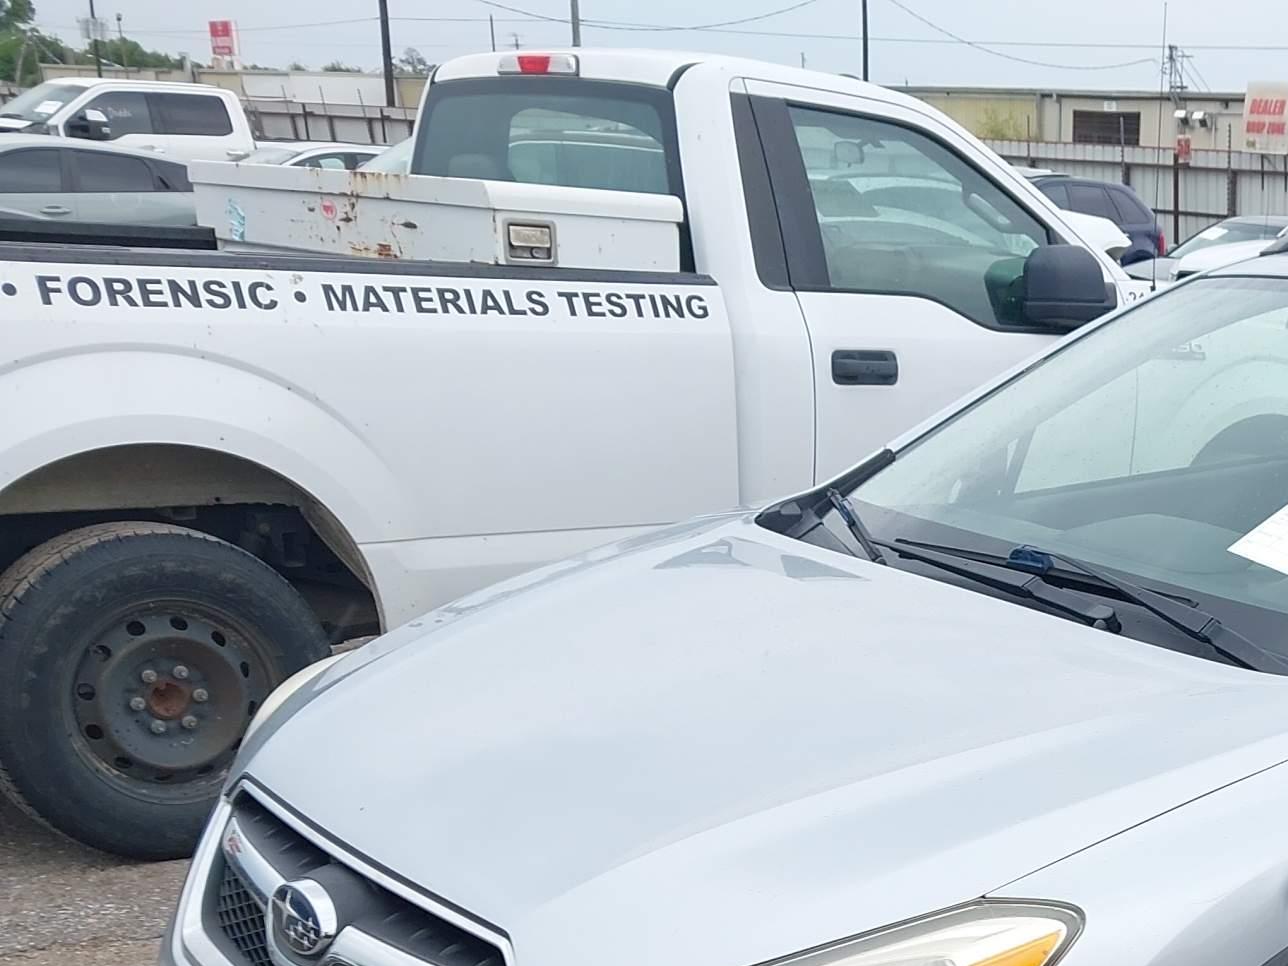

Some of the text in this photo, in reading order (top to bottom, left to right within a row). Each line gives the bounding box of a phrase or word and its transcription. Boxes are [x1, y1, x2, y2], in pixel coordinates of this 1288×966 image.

[1249, 98, 1287, 115] DEALER
[35, 275, 279, 311] FORENSIC
[321, 283, 710, 320] MATERIALS TESTING
